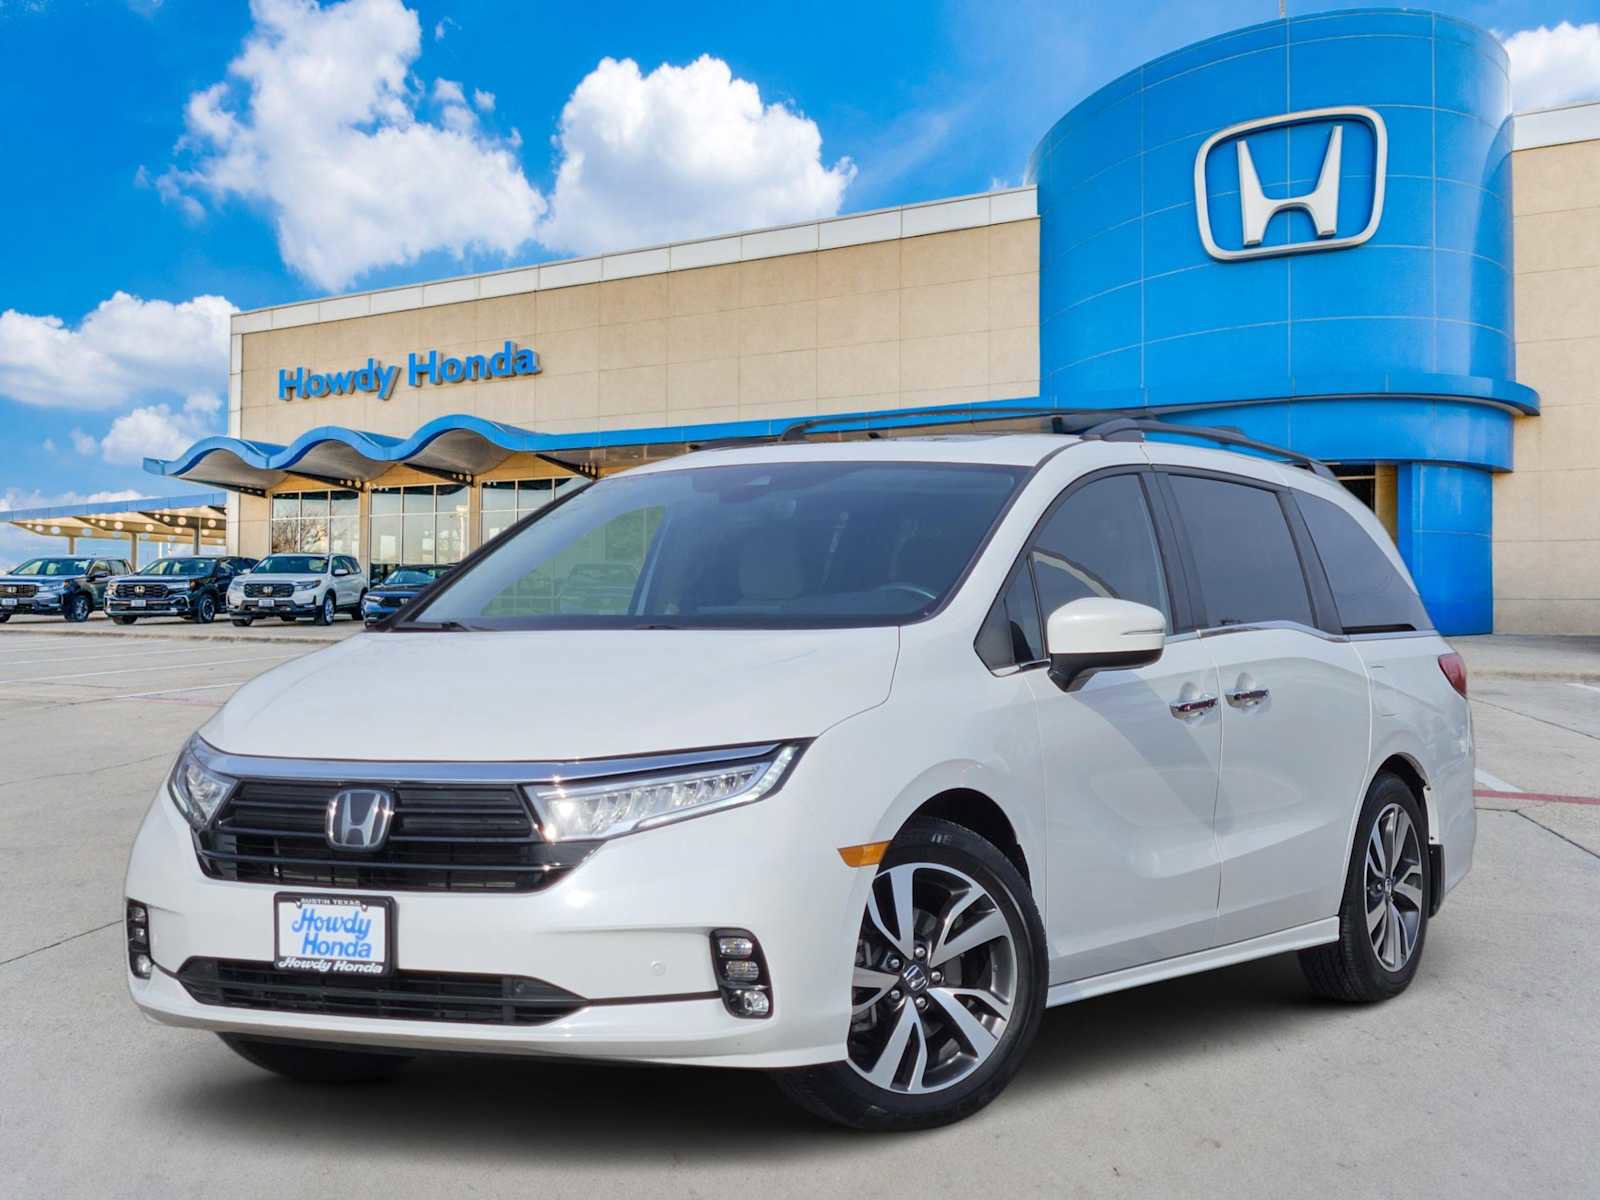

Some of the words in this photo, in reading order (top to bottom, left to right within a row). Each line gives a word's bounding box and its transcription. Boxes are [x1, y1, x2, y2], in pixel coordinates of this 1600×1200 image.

[278, 358, 401, 401] Howdy
[407, 340, 542, 387] Honda
[291, 907, 372, 940] Howdy
[301, 931, 372, 959] Honda
[278, 956, 332, 973] Howdy
[333, 960, 383, 974] Honda
